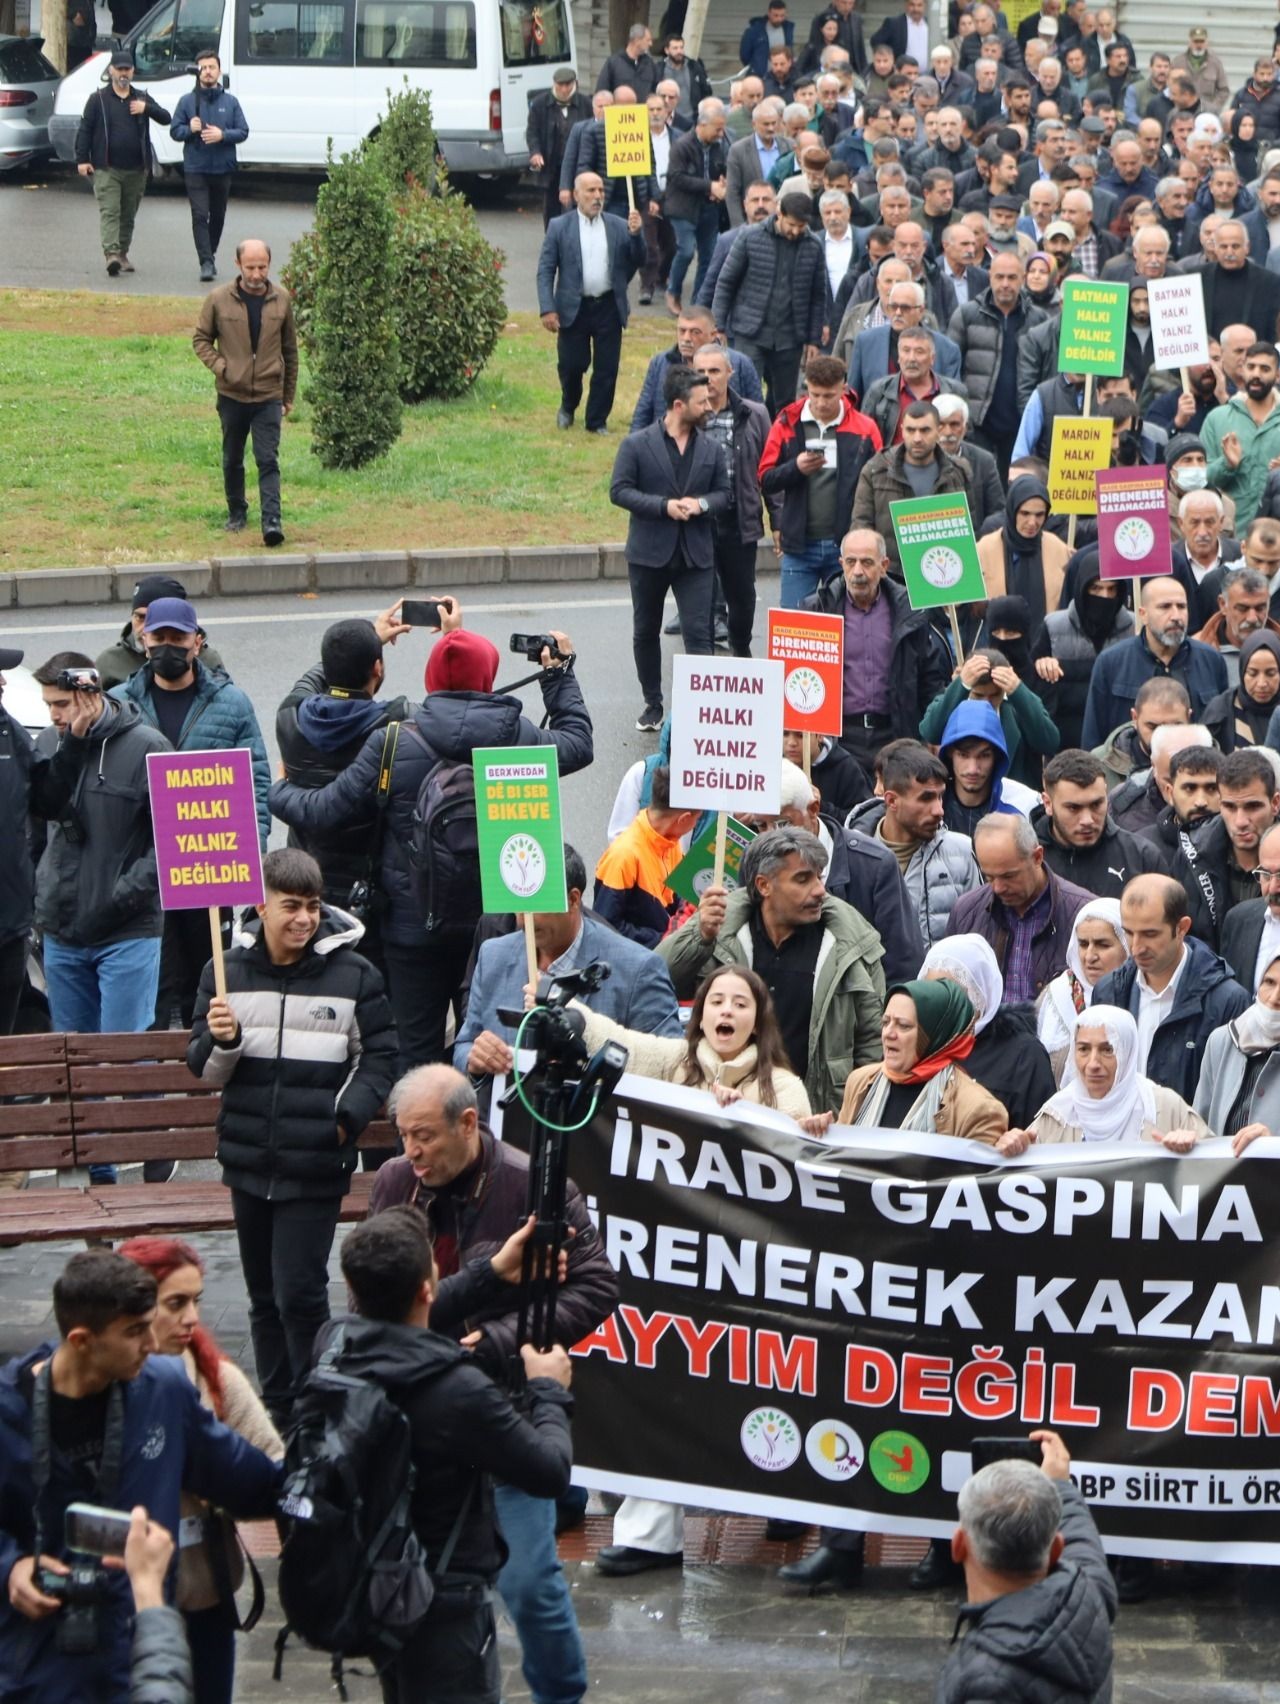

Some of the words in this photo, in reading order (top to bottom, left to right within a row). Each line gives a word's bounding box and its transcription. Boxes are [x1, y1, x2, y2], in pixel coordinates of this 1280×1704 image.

[1072, 289, 1118, 305] BATMAN
[1154, 287, 1192, 302] BATMAN
[1077, 310, 1110, 323] HALKI
[1161, 307, 1188, 319] HALKI
[1073, 328, 1112, 343] YALNIZ
[1161, 324, 1193, 338] YALNIZ
[1065, 345, 1117, 363] DEĞİLDİR
[1158, 342, 1200, 358] DEĞİLDİR
[1061, 428, 1101, 441] MARDİN
[1064, 449, 1095, 461] HALKI
[1060, 469, 1095, 481] YALNIZ
[1052, 486, 1096, 501] DEĞİLDİR
[1100, 488, 1165, 504] DİRENEREK
[1100, 499, 1166, 514] KAZANACAĞIZ
[898, 516, 969, 536] DİRENEREK
[901, 527, 971, 545] KAZANACAĞIZ
[772, 635, 839, 654] DİRENEREK
[773, 648, 839, 664] KAZANACAĞIZ
[690, 673, 764, 695] BATMAN
[699, 706, 753, 726] HALKI
[693, 738, 757, 759] YALNIZ
[166, 763, 234, 789] MARDİN
[488, 766, 545, 778] BERXWEDAN
[682, 767, 766, 792] DEĞİLDİR
[506, 784, 521, 799] BI
[523, 784, 549, 799] SER
[177, 800, 230, 820] HALKI
[487, 802, 551, 821] BIKEVE
[175, 832, 238, 853] YALNIZ
[169, 860, 251, 886] DEĞİLDİR
[609, 1106, 846, 1213] İRADE
[870, 1174, 1263, 1242] GASPINA
[587, 1195, 984, 1329] RENEREK
[569, 1303, 818, 1397] AYYIM
[843, 1344, 1100, 1428] DEĞİL
[753, 1454, 768, 1469] DEM
[887, 1472, 910, 1484] DBP
[1125, 1471, 1199, 1504] SİİRT
[1208, 1474, 1233, 1505] İL
